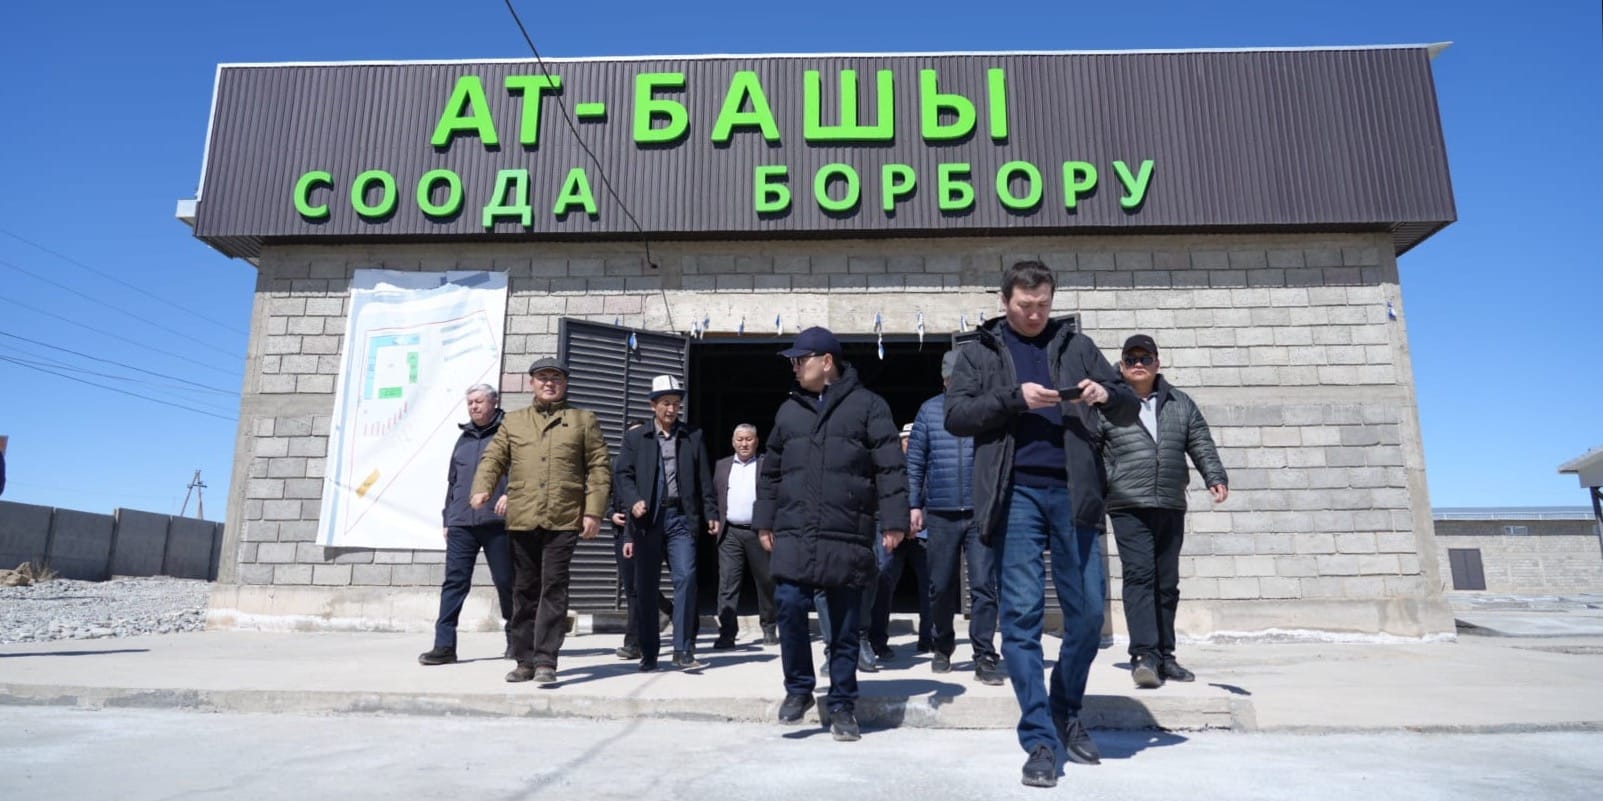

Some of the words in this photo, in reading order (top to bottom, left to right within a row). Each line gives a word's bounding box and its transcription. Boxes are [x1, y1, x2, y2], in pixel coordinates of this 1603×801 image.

[431, 68, 1010, 147] АТ-БАШЫ
[294, 168, 597, 229] СООДА
[755, 160, 1155, 213] БОРБОРУ
